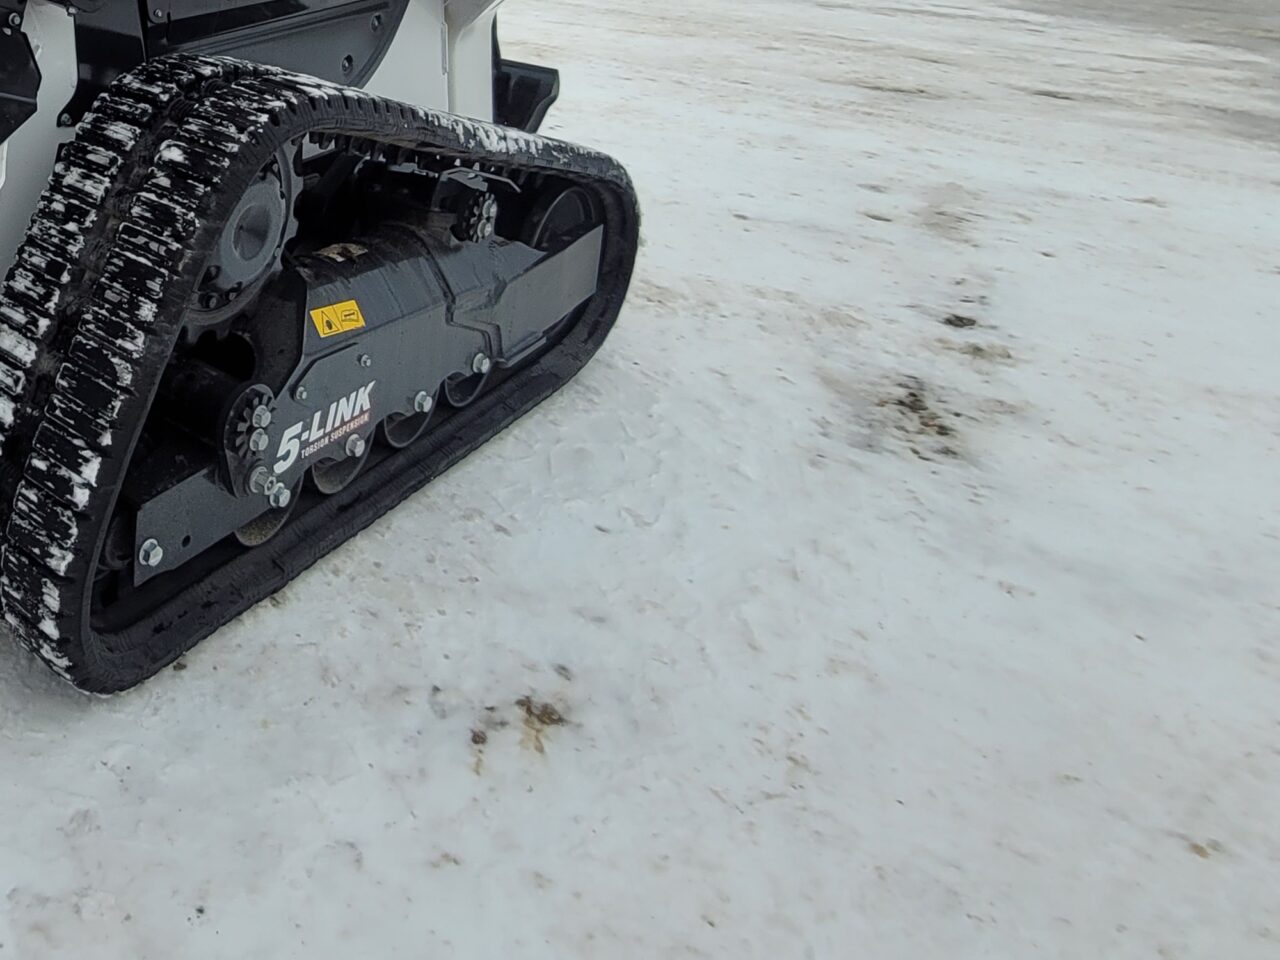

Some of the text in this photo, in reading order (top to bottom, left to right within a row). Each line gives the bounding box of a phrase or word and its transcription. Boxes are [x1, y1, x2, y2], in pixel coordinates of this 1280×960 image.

[272, 380, 376, 474] 5-LINK
[301, 413, 369, 459] TORSION SUSPENSION
